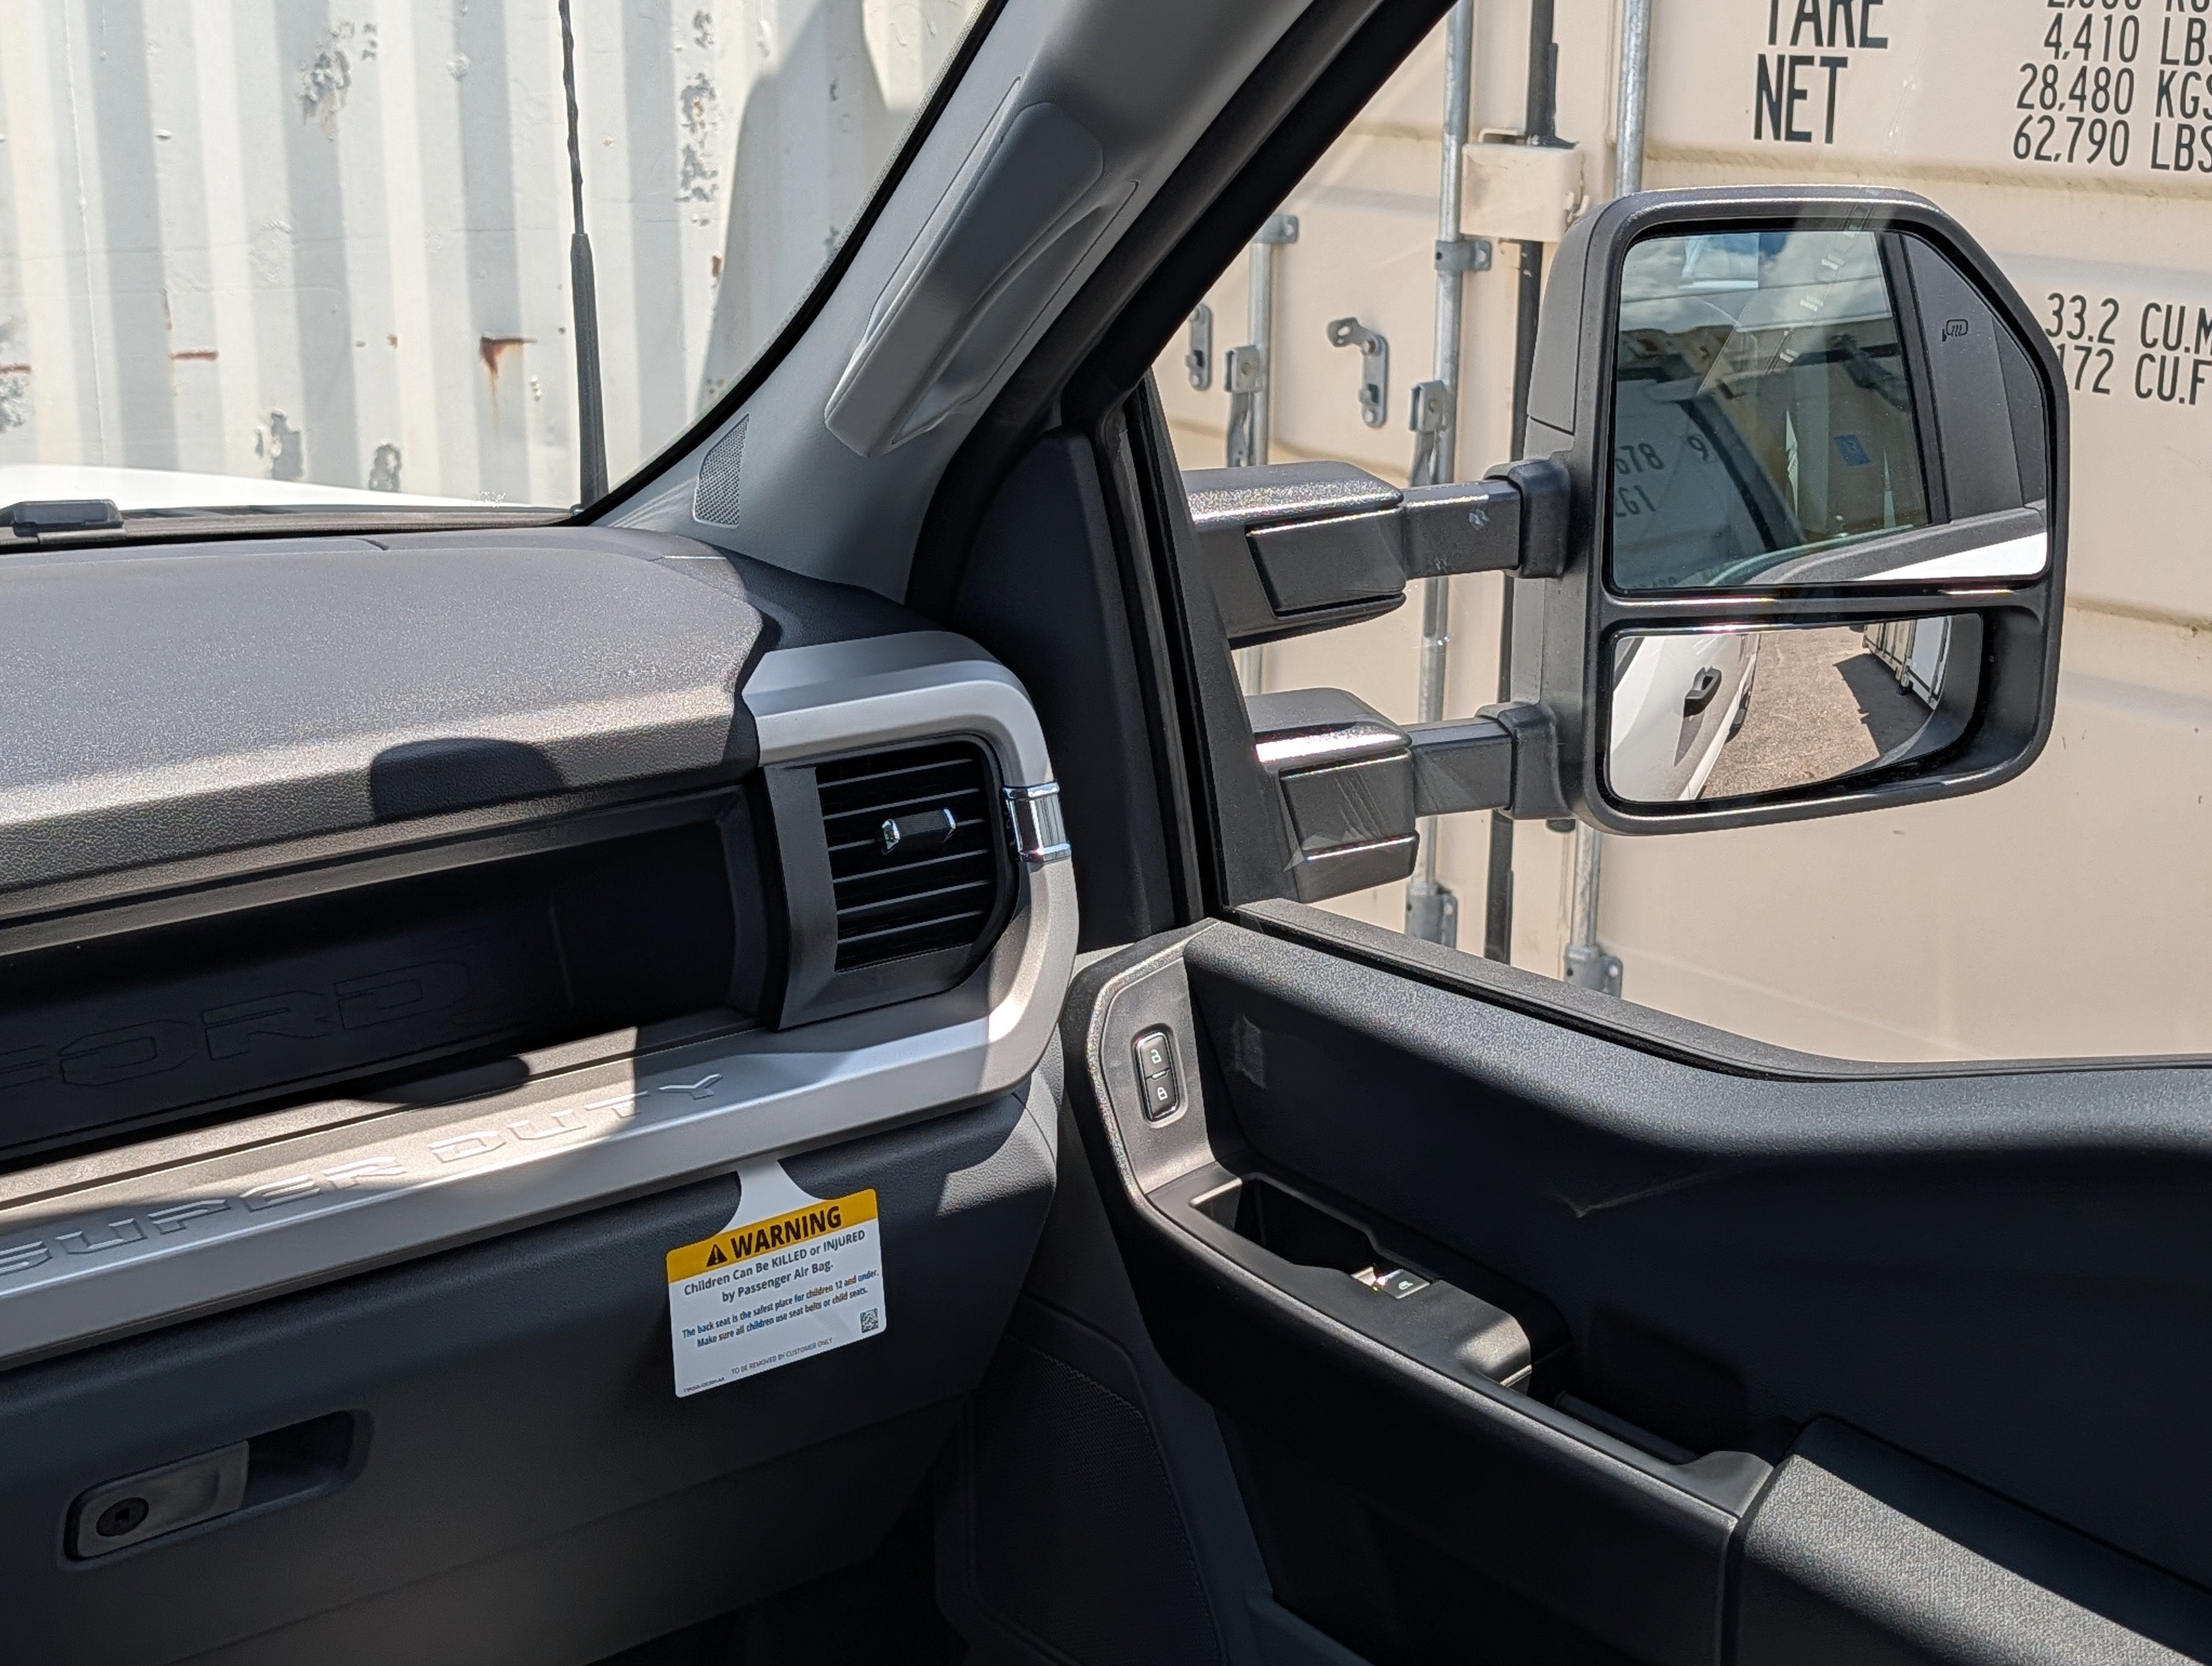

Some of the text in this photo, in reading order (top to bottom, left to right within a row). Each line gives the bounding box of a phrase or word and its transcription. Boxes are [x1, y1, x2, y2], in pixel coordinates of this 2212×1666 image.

[2043, 12, 2212, 66] 4,410 LB
[1753, 53, 1848, 144] NET
[2016, 63, 2134, 115] 28,480
[2013, 114, 2212, 173] 62,790 LBS
[2044, 292, 2212, 356] 33.2 CU.M
[0, 1073, 723, 1276] SUPER DUTY
[730, 1206, 842, 1259] WARNING
[684, 1229, 865, 1296] Children Can Be KILLED or INJURED
[722, 1260, 834, 1303] by Passenger Air Bag.
[682, 1328, 696, 1339] The
[697, 1322, 714, 1334] back
[715, 1317, 731, 1328] seat
[732, 1313, 738, 1323] is
[740, 1310, 751, 1321] the
[753, 1303, 774, 1316] safest
[775, 1297, 793, 1311] place
[794, 1293, 805, 1303] for
[806, 1285, 833, 1299] children
[844, 1274, 857, 1287] and
[697, 1335, 717, 1348] Make
[718, 1329, 734, 1341] sure
[736, 1324, 745, 1336] all
[746, 1317, 774, 1332] children
[775, 1312, 788, 1323] use
[789, 1306, 804, 1318] seat
[805, 1302, 822, 1313] belts
[823, 1299, 831, 1307] or
[832, 1291, 848, 1304] child
[749, 1355, 777, 1369] REMOVED
[786, 1342, 816, 1357] CUSTOMER
